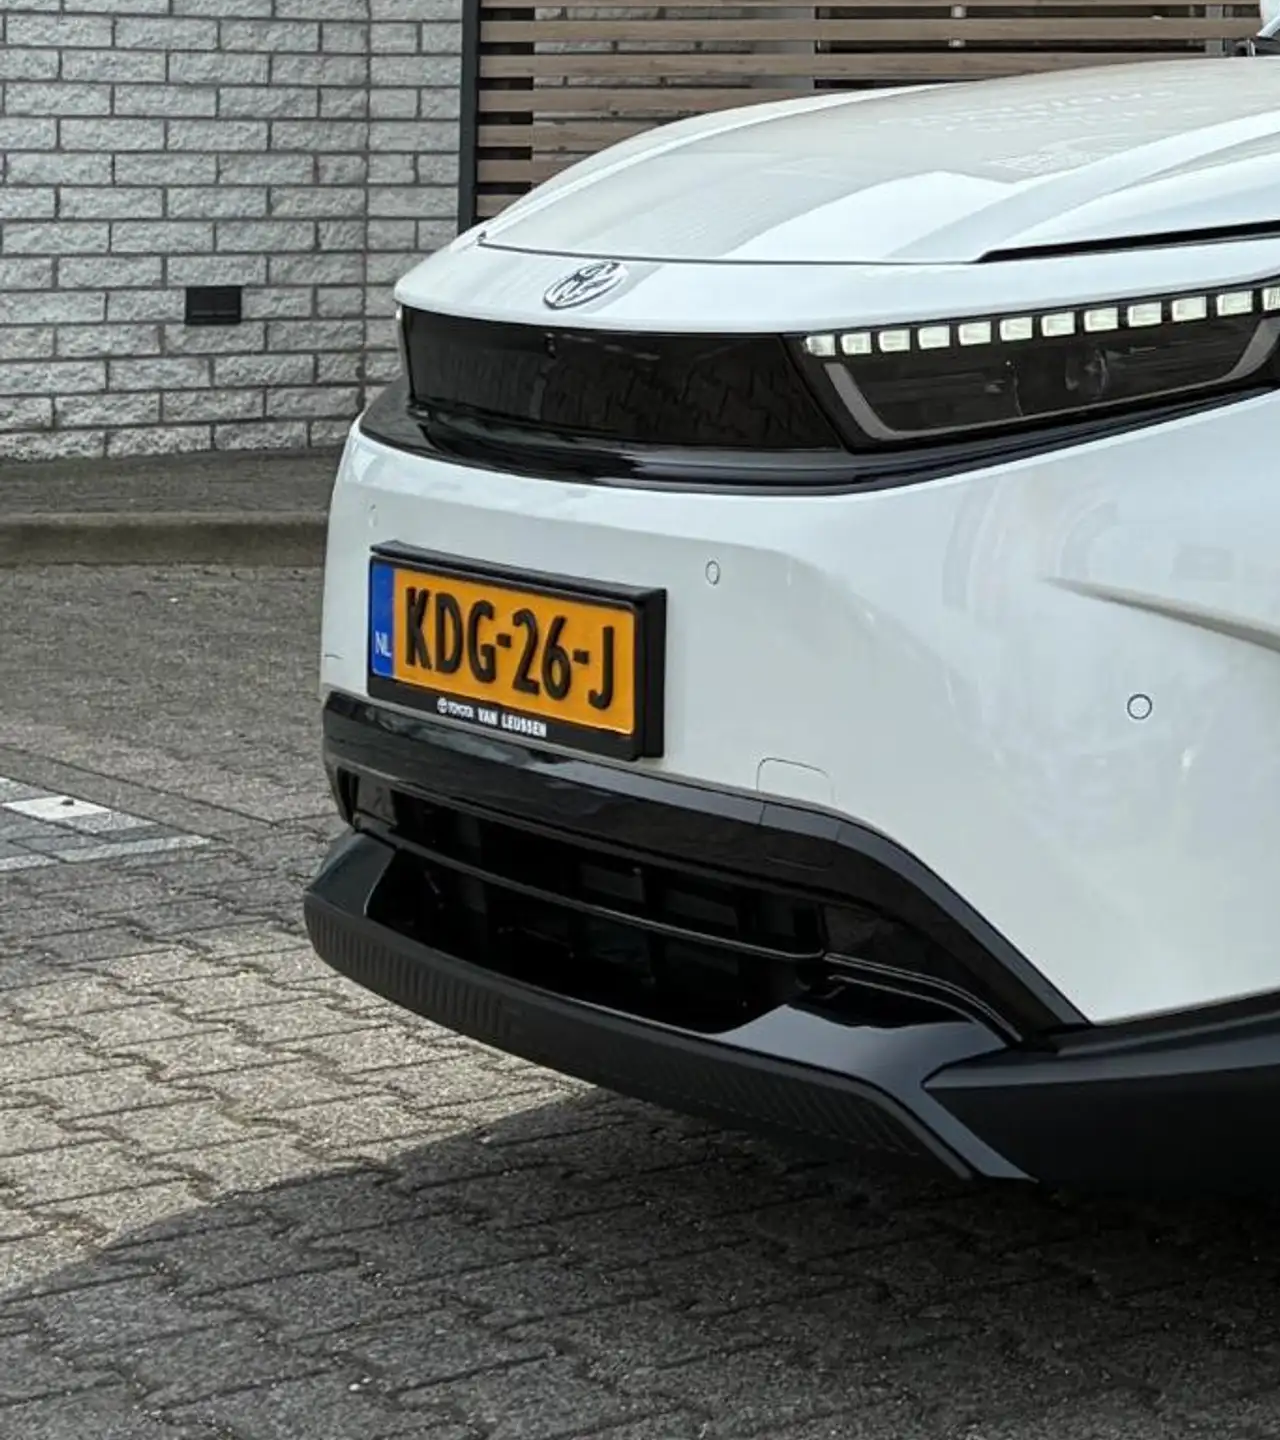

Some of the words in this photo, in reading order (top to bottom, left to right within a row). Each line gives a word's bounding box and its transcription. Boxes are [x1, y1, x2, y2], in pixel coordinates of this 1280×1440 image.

[374, 630, 392, 658] NL
[405, 586, 615, 711] KDG-26-J
[477, 706, 499, 726] VAN
[501, 712, 548, 738] LEUSSEN
